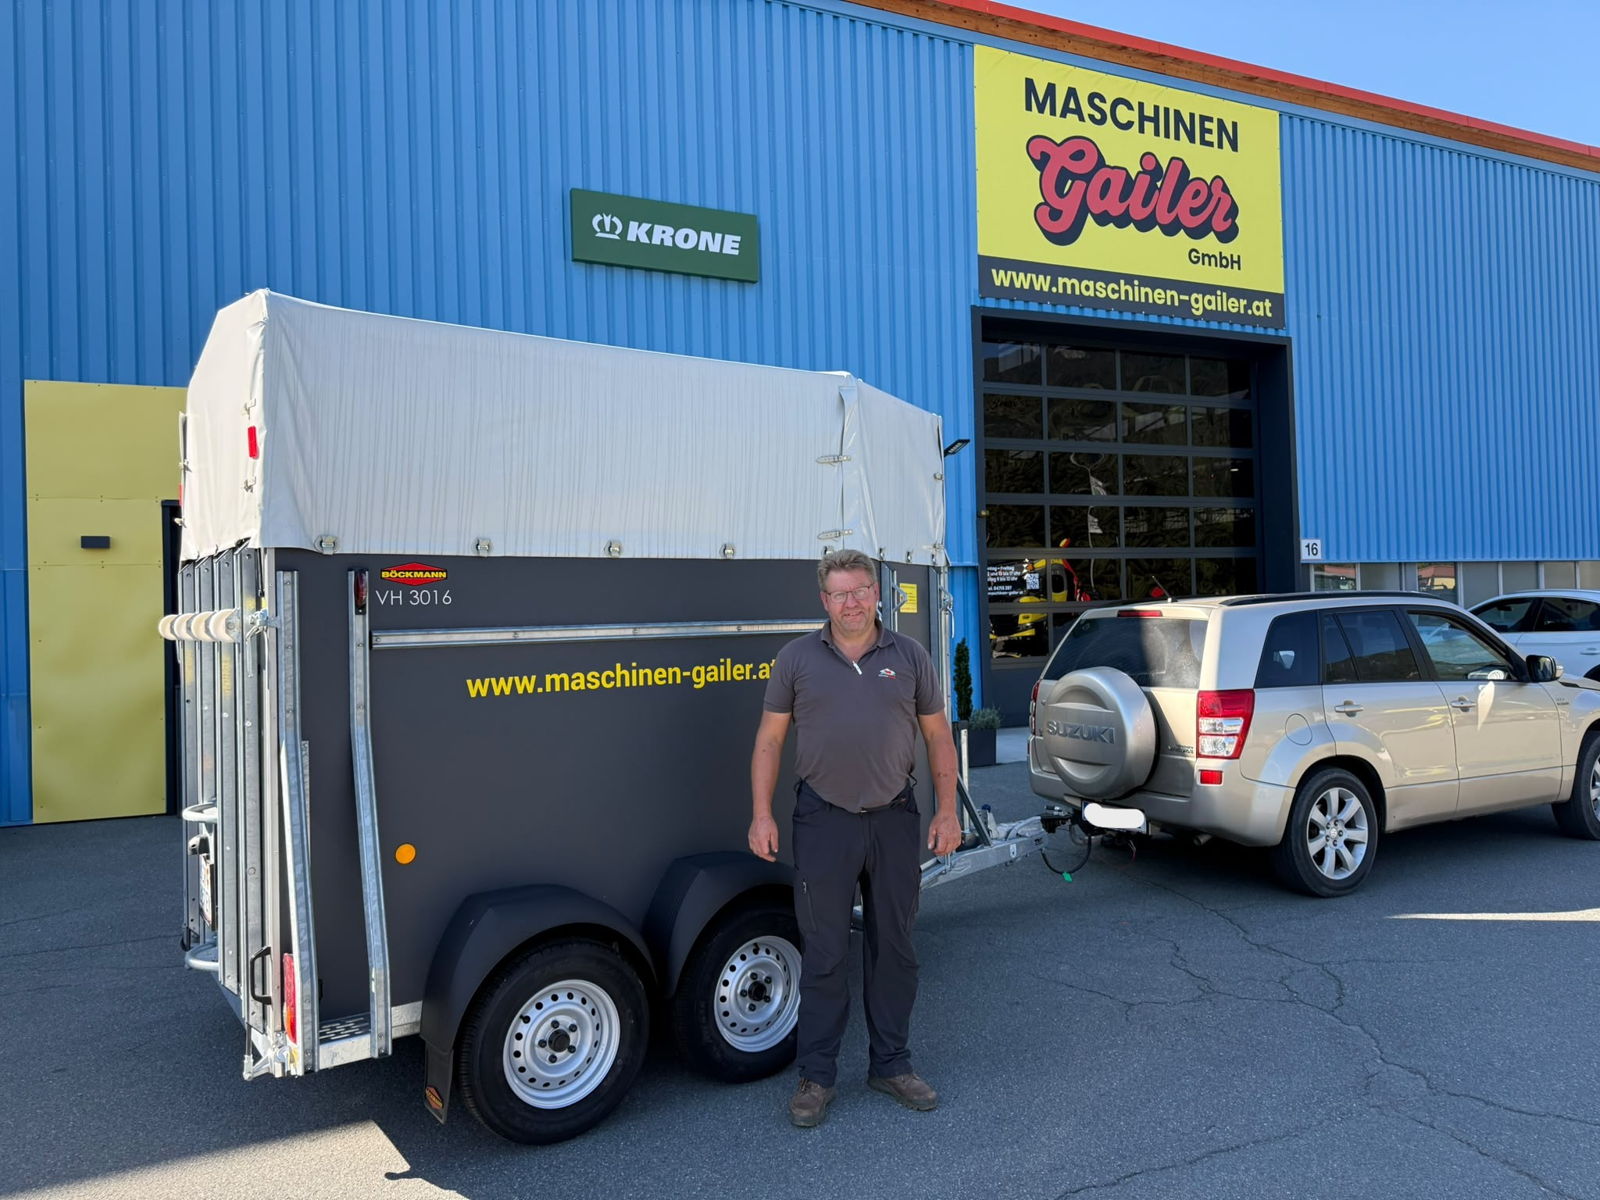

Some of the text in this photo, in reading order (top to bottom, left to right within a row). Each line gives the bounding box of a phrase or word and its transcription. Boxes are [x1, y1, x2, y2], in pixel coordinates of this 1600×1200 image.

[1024, 77, 1239, 153] MASCHINEN
[1026, 135, 1239, 246] Gailer
[626, 220, 742, 256] KRONE
[1188, 248, 1241, 271] GmbH
[991, 268, 1272, 317] www.maschinen-gailer.at
[1304, 542, 1319, 556] 16
[381, 569, 447, 578] BÖCKMANN
[375, 589, 452, 606] VH 3016
[1047, 720, 1115, 744] SUZUKI
